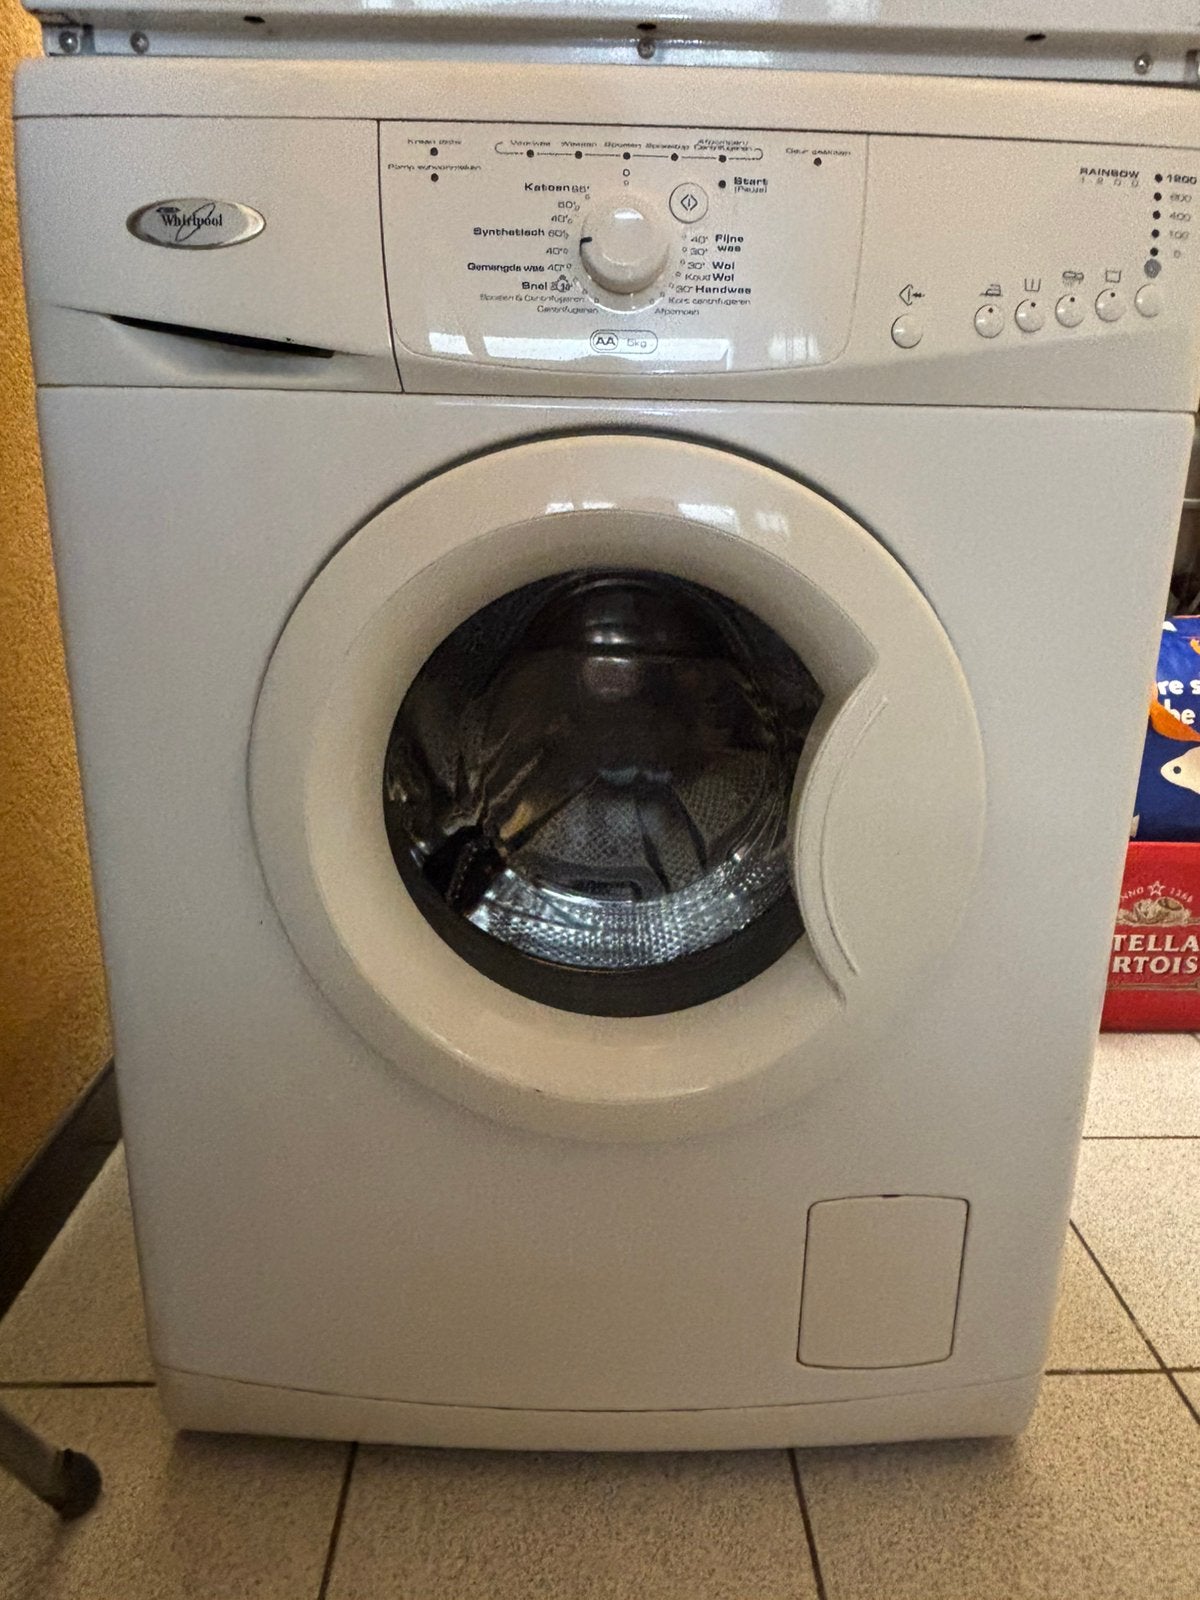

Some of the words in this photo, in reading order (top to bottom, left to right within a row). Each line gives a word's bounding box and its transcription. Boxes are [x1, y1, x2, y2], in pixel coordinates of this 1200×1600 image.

[1080, 167, 1140, 179] RAINBOW
[733, 176, 769, 187] Start
[524, 182, 570, 193] Katoen
[160, 212, 223, 230] Whirlpool
[473, 226, 545, 237] Synthetisch
[715, 233, 744, 244] Fijne
[712, 261, 735, 270] Wol
[712, 272, 735, 282] Wol
[695, 285, 752, 295] Handwas
[595, 336, 616, 346] AA
[1111, 955, 1198, 974] RTOIS
